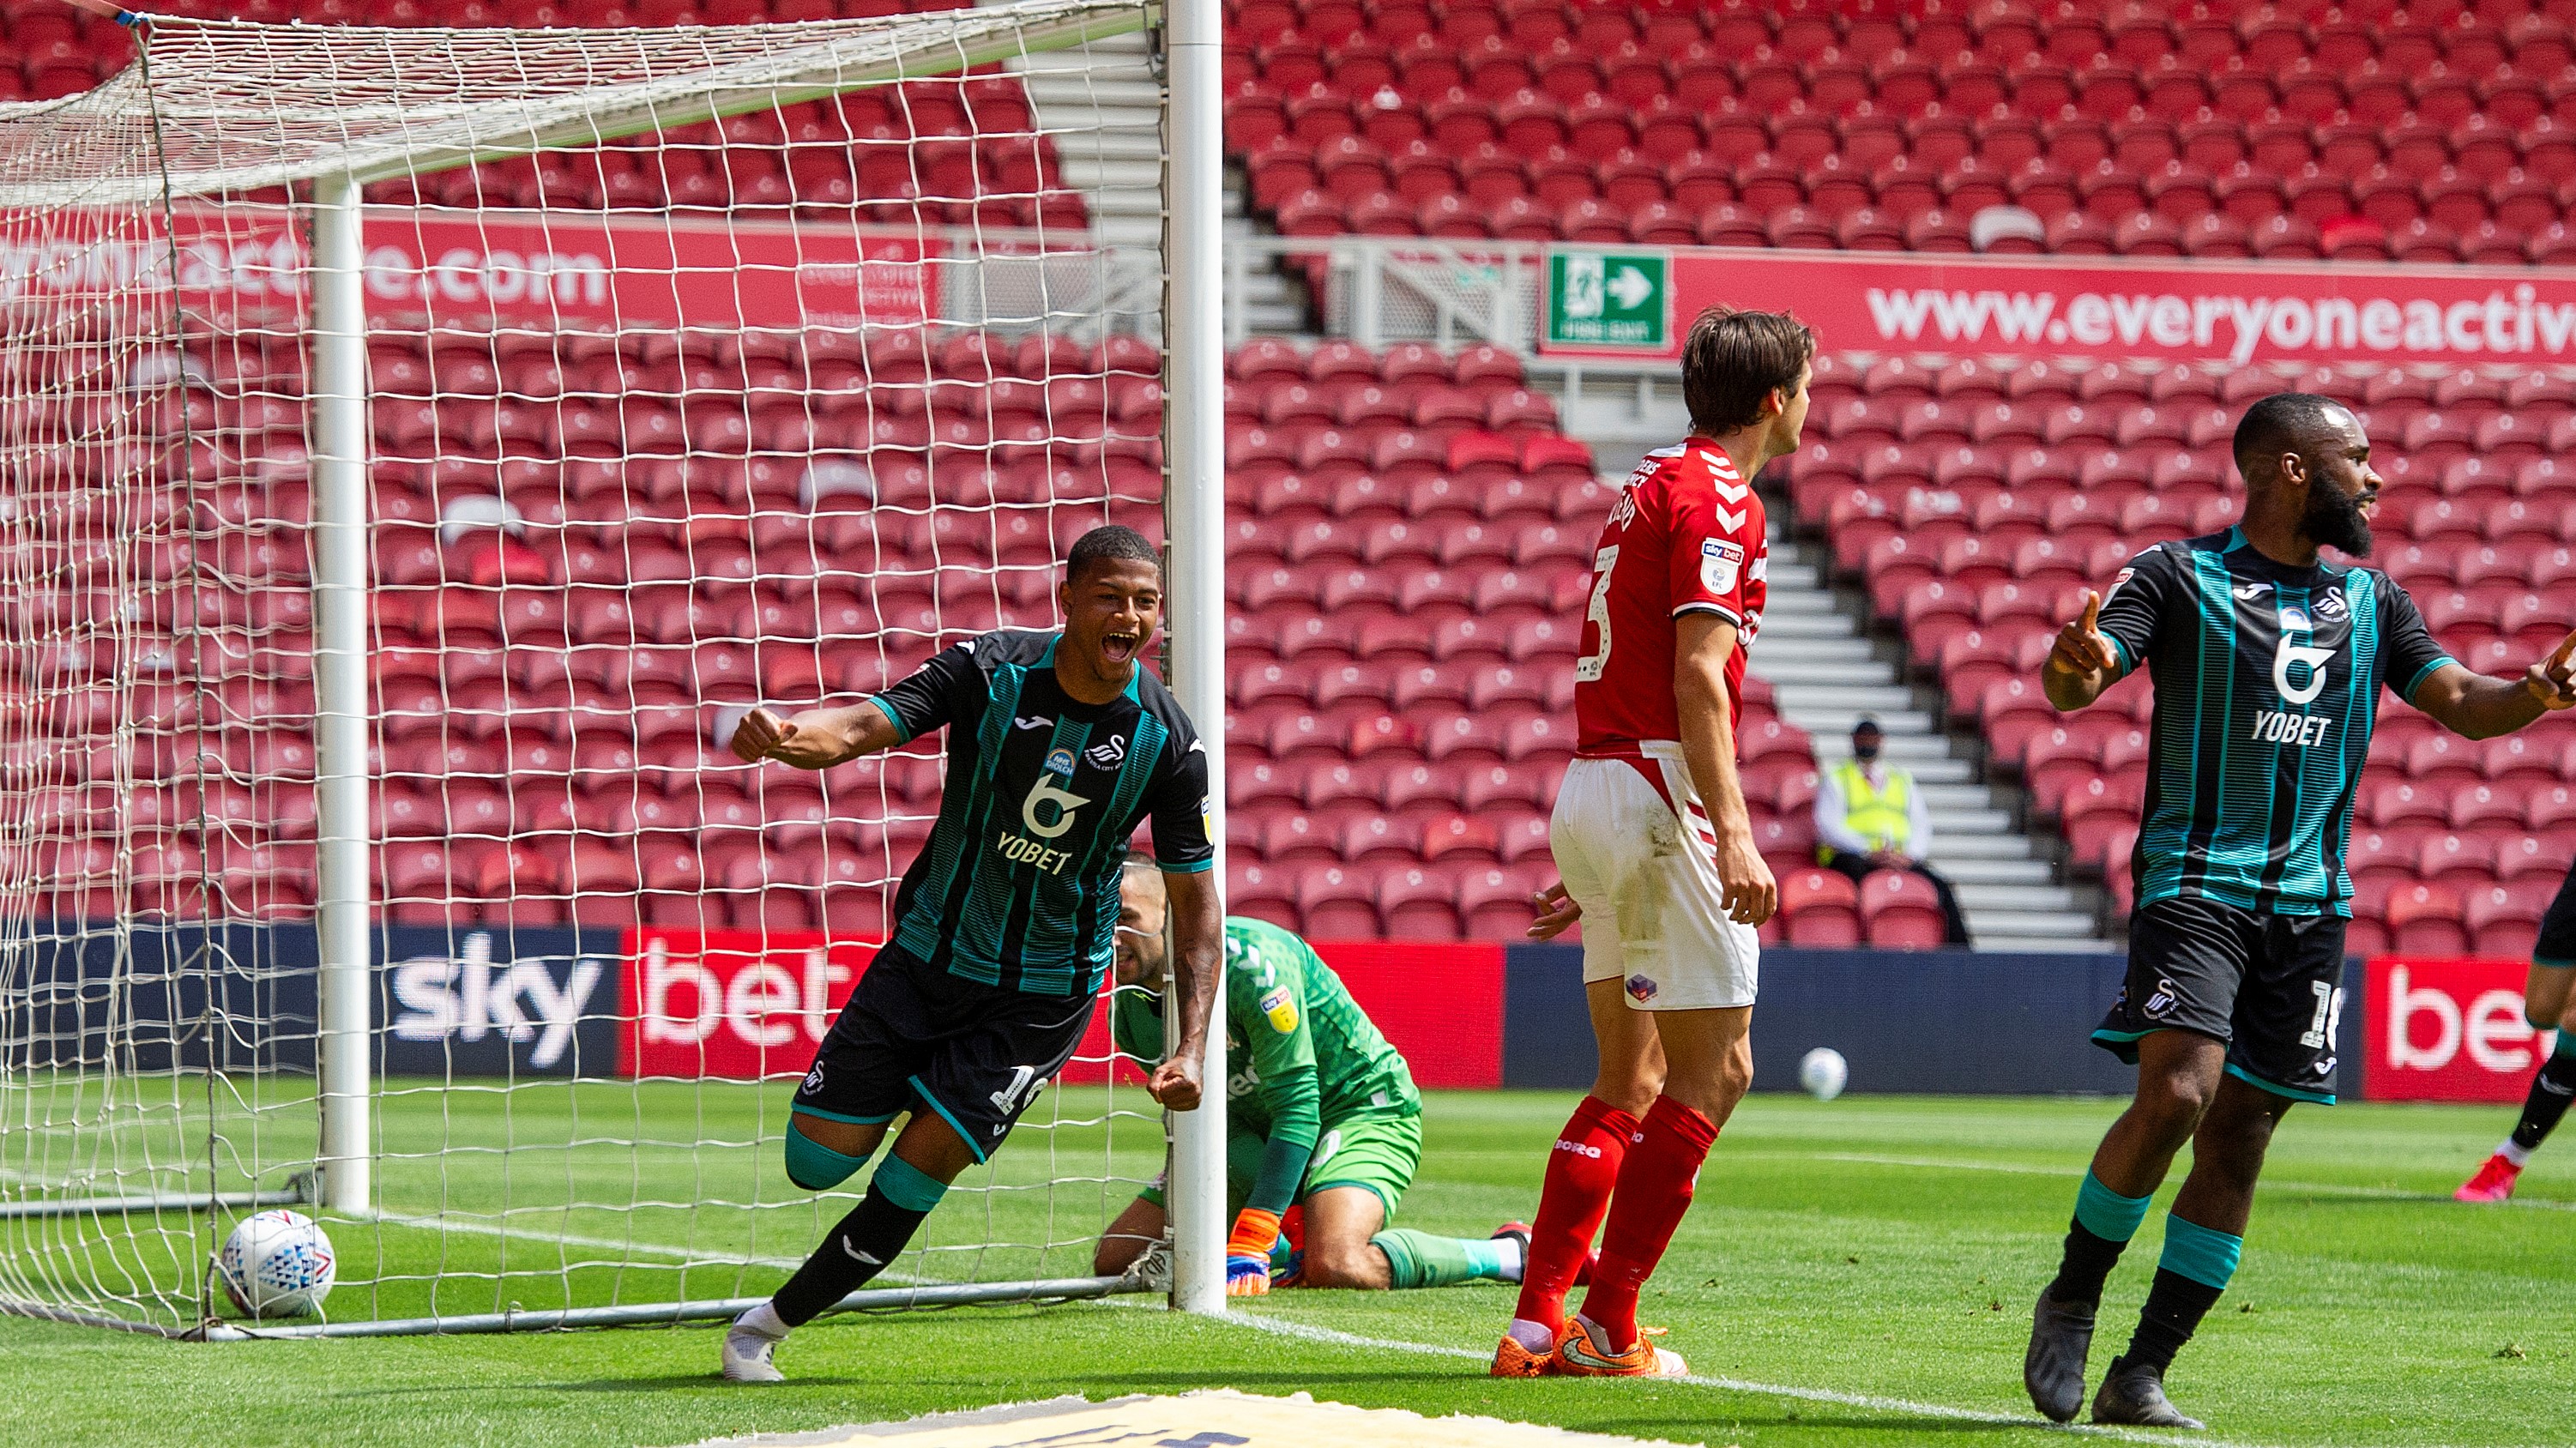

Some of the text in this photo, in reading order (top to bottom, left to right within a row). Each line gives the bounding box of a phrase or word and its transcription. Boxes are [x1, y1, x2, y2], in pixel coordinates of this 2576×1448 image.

[1704, 544, 1740, 562] sky bet
[1712, 581, 1722, 589] EFL
[1575, 544, 1620, 683] 3
[2252, 710, 2332, 747] YOBET
[997, 830, 1072, 876] YOBET
[393, 932, 602, 1069] sky
[2387, 962, 2559, 1072] be
